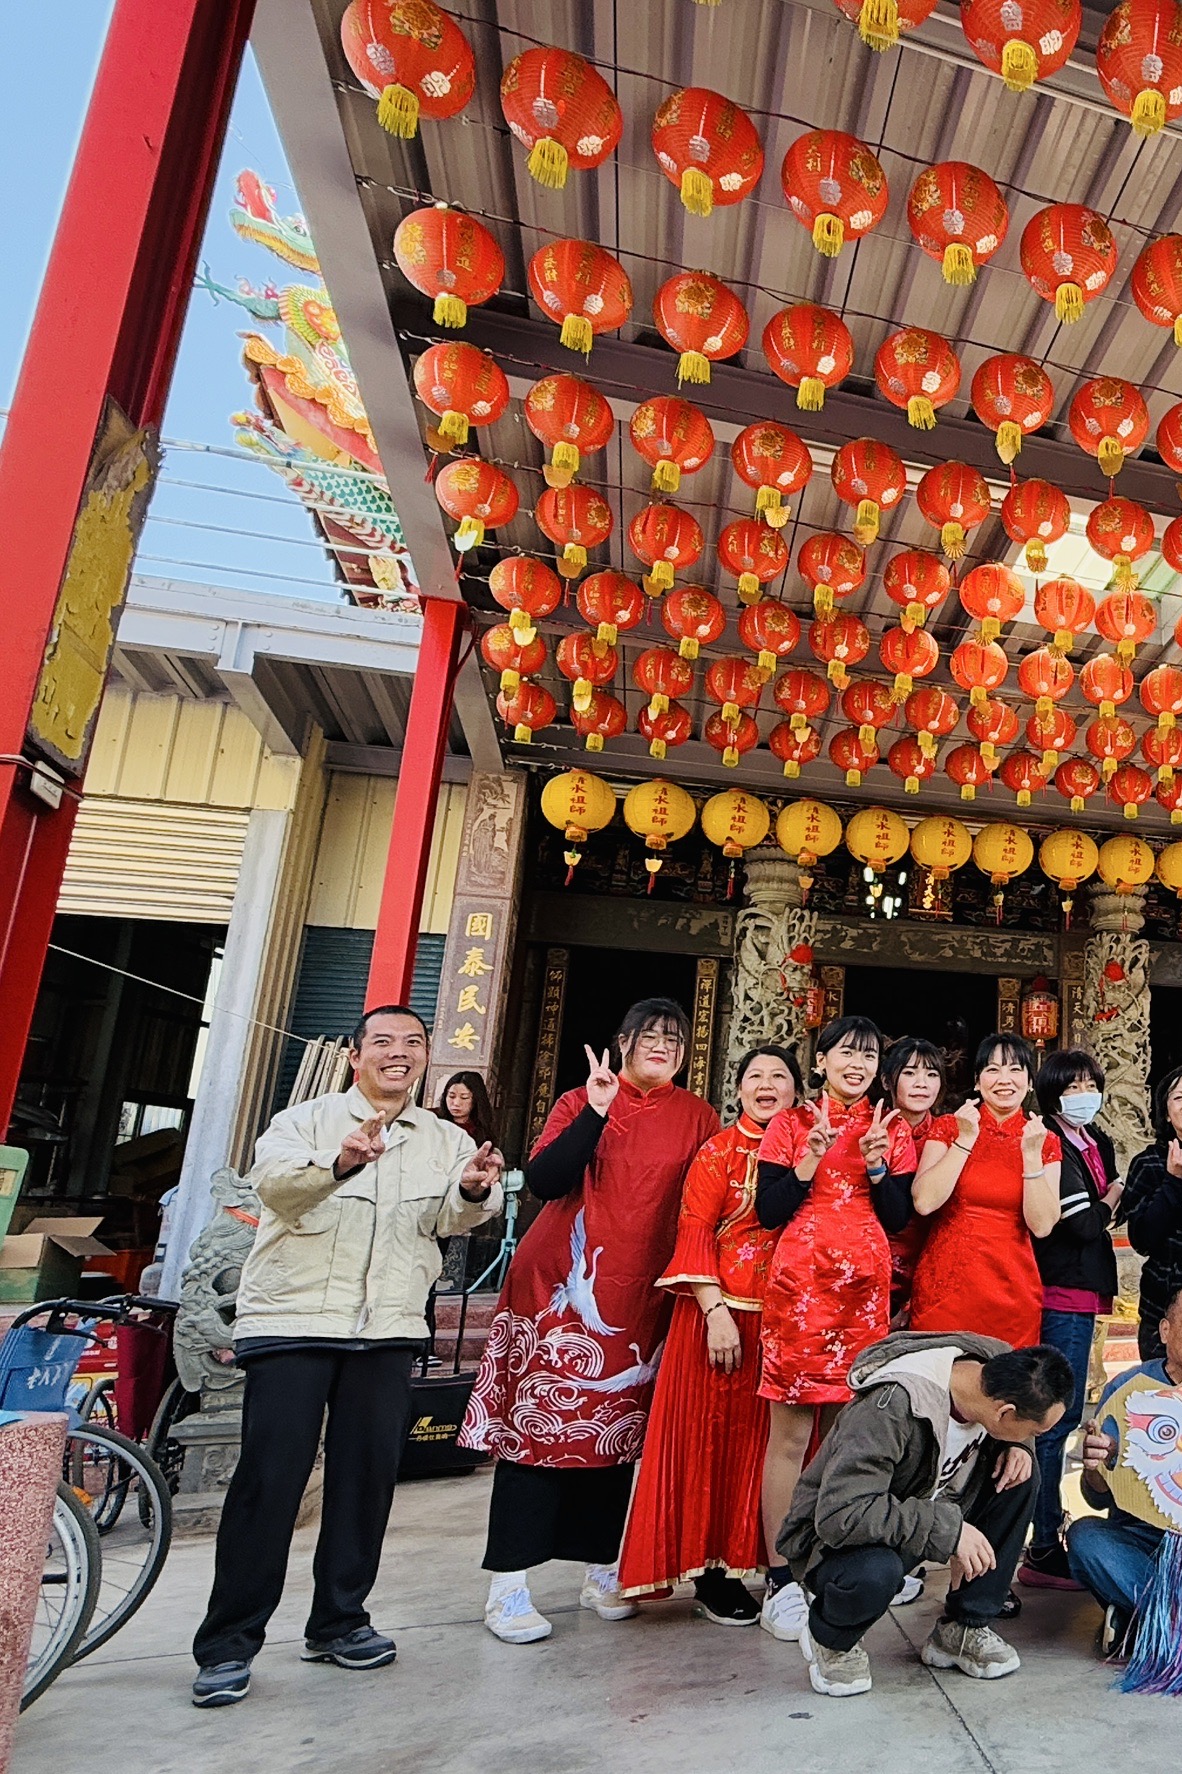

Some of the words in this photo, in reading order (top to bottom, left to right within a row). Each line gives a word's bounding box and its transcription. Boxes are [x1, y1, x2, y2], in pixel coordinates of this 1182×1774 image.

[570, 776, 588, 816] 清水祖師
[651, 787, 669, 827] 清水祖師
[729, 796, 748, 835] 清水祖師
[804, 805, 821, 844] 清水祖師
[874, 813, 891, 851] 清水祖師
[940, 821, 956, 858] 清水祖師
[1001, 828, 1018, 864] 清水祖師
[1069, 834, 1084, 869] 清水祖師
[1127, 840, 1142, 875] 清水祖師
[447, 912, 494, 1050] 國泰民安
